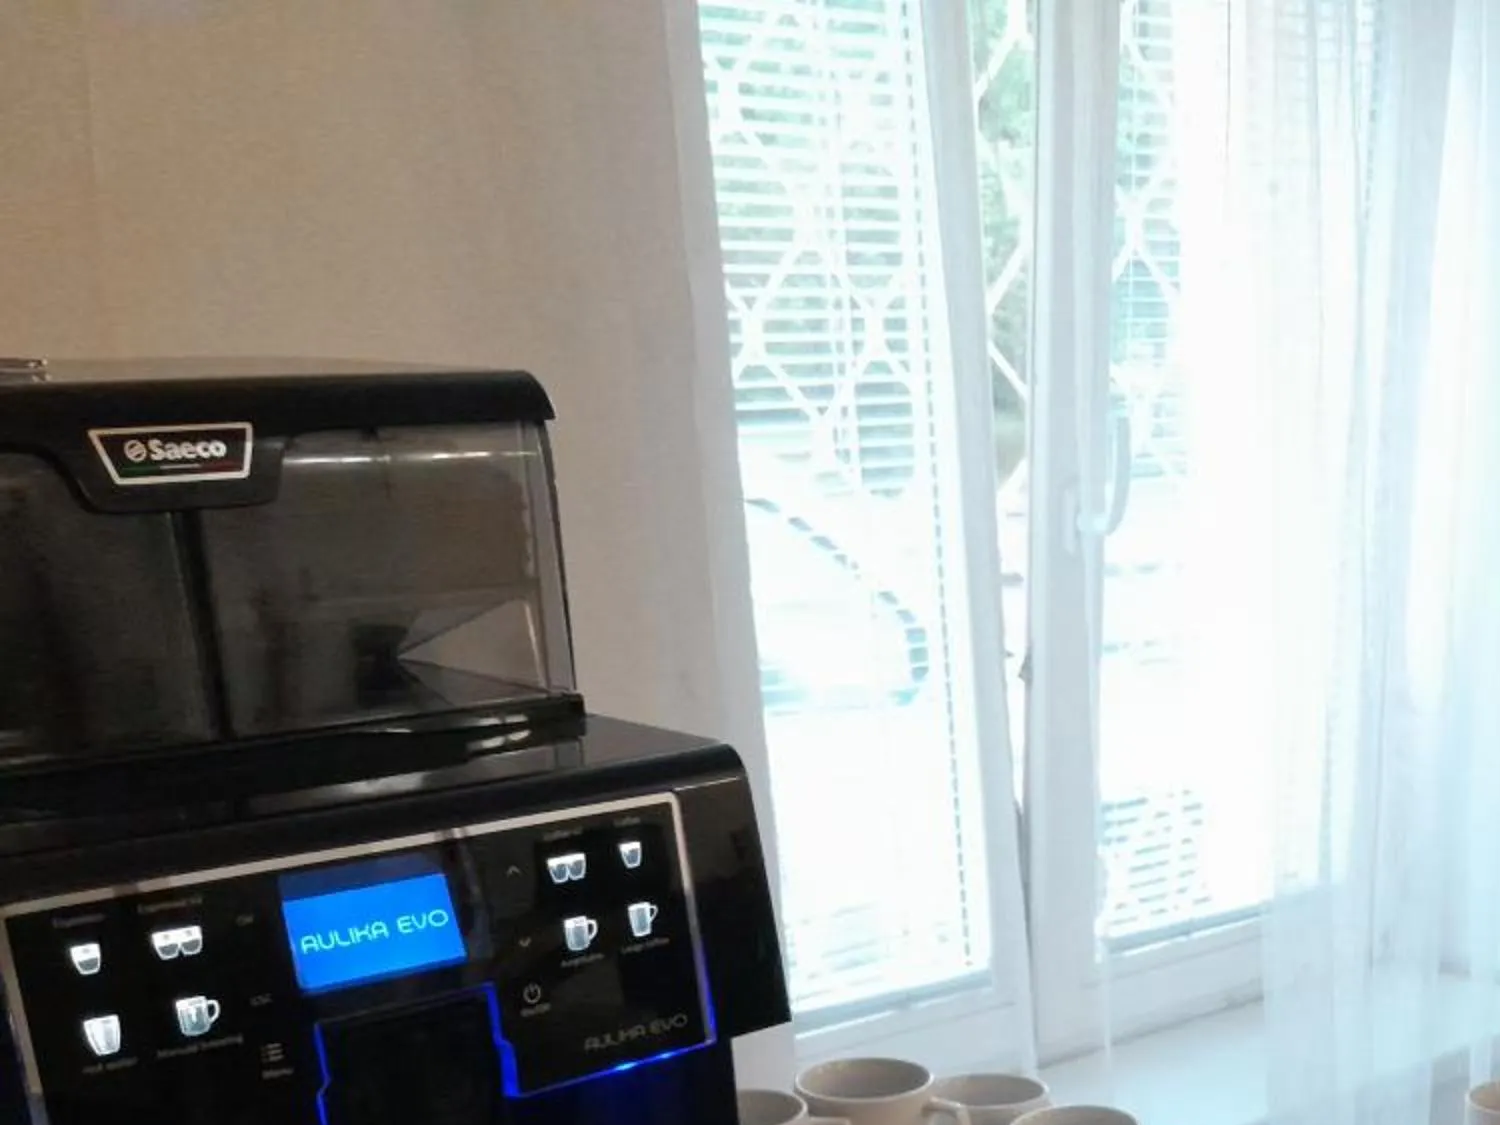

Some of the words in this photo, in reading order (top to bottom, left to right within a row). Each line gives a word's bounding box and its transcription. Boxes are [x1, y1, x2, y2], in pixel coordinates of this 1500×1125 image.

[148, 438, 227, 461] Saeco
[301, 921, 390, 954] AULIKA
[396, 909, 449, 934] EVO
